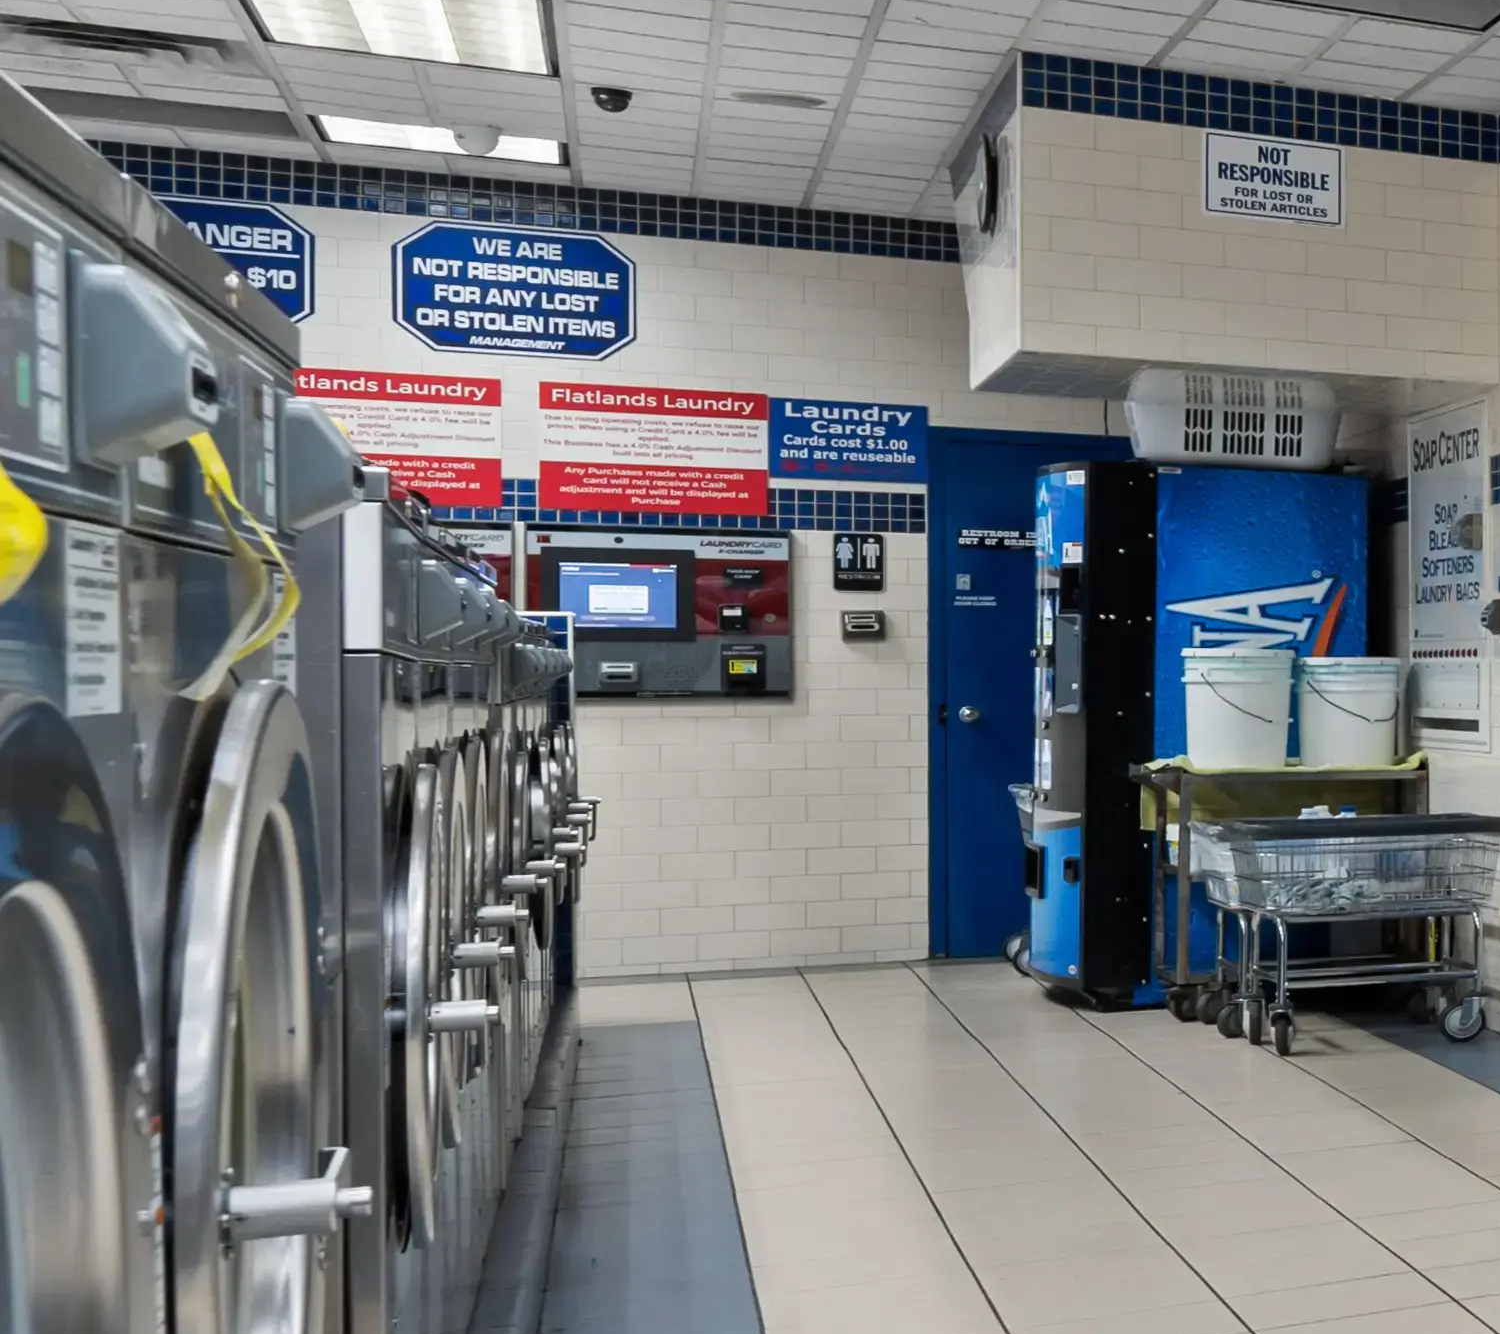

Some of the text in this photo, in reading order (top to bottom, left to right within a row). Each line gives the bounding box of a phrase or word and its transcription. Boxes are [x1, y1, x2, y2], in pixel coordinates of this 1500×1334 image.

[1258, 145, 1291, 166] NOT
[1218, 161, 1330, 191] RESPONSIBLE
[1234, 186, 1313, 204] FOR LOST OR
[1220, 197, 1327, 218] STOLEN ARTICLES
[187, 222, 293, 252] ANGER
[473, 237, 562, 262] WE ARE
[248, 267, 296, 291] $10
[413, 257, 619, 290] NOT RESPONSIBLE
[434, 285, 599, 313] FOR ANY LOST
[415, 307, 616, 338] OR STOLEN ITEMS
[469, 336, 566, 351] MANAGEMENT
[296, 374, 487, 401] tlands Laundry
[551, 388, 754, 415] Flatlands Laundry
[785, 402, 912, 427] Laundry
[811, 421, 886, 436] Cards
[783, 434, 908, 451] Cards cost $1.00
[1413, 427, 1480, 473] SOAP CENTER
[780, 448, 916, 464] and are reuseable
[564, 466, 585, 475] Any
[588, 467, 643, 477] Purchases
[646, 470, 676, 478] made
[679, 471, 703, 479] with
[714, 472, 744, 481] credit
[583, 476, 607, 485] card
[610, 477, 629, 485] will
[632, 478, 650, 486] not
[653, 479, 690, 487] receive
[701, 480, 726, 489] Cash
[559, 485, 749, 499] adjustment and will be displayed at
[631, 497, 680, 506] Purchase
[700, 540, 782, 548] LAUNDRYCARD
[962, 530, 1020, 538] RESTROOM
[985, 538, 998, 546] OF
[1421, 555, 1475, 579] SOFTENERS
[1415, 581, 1480, 604] LAUNDRY BAGS
